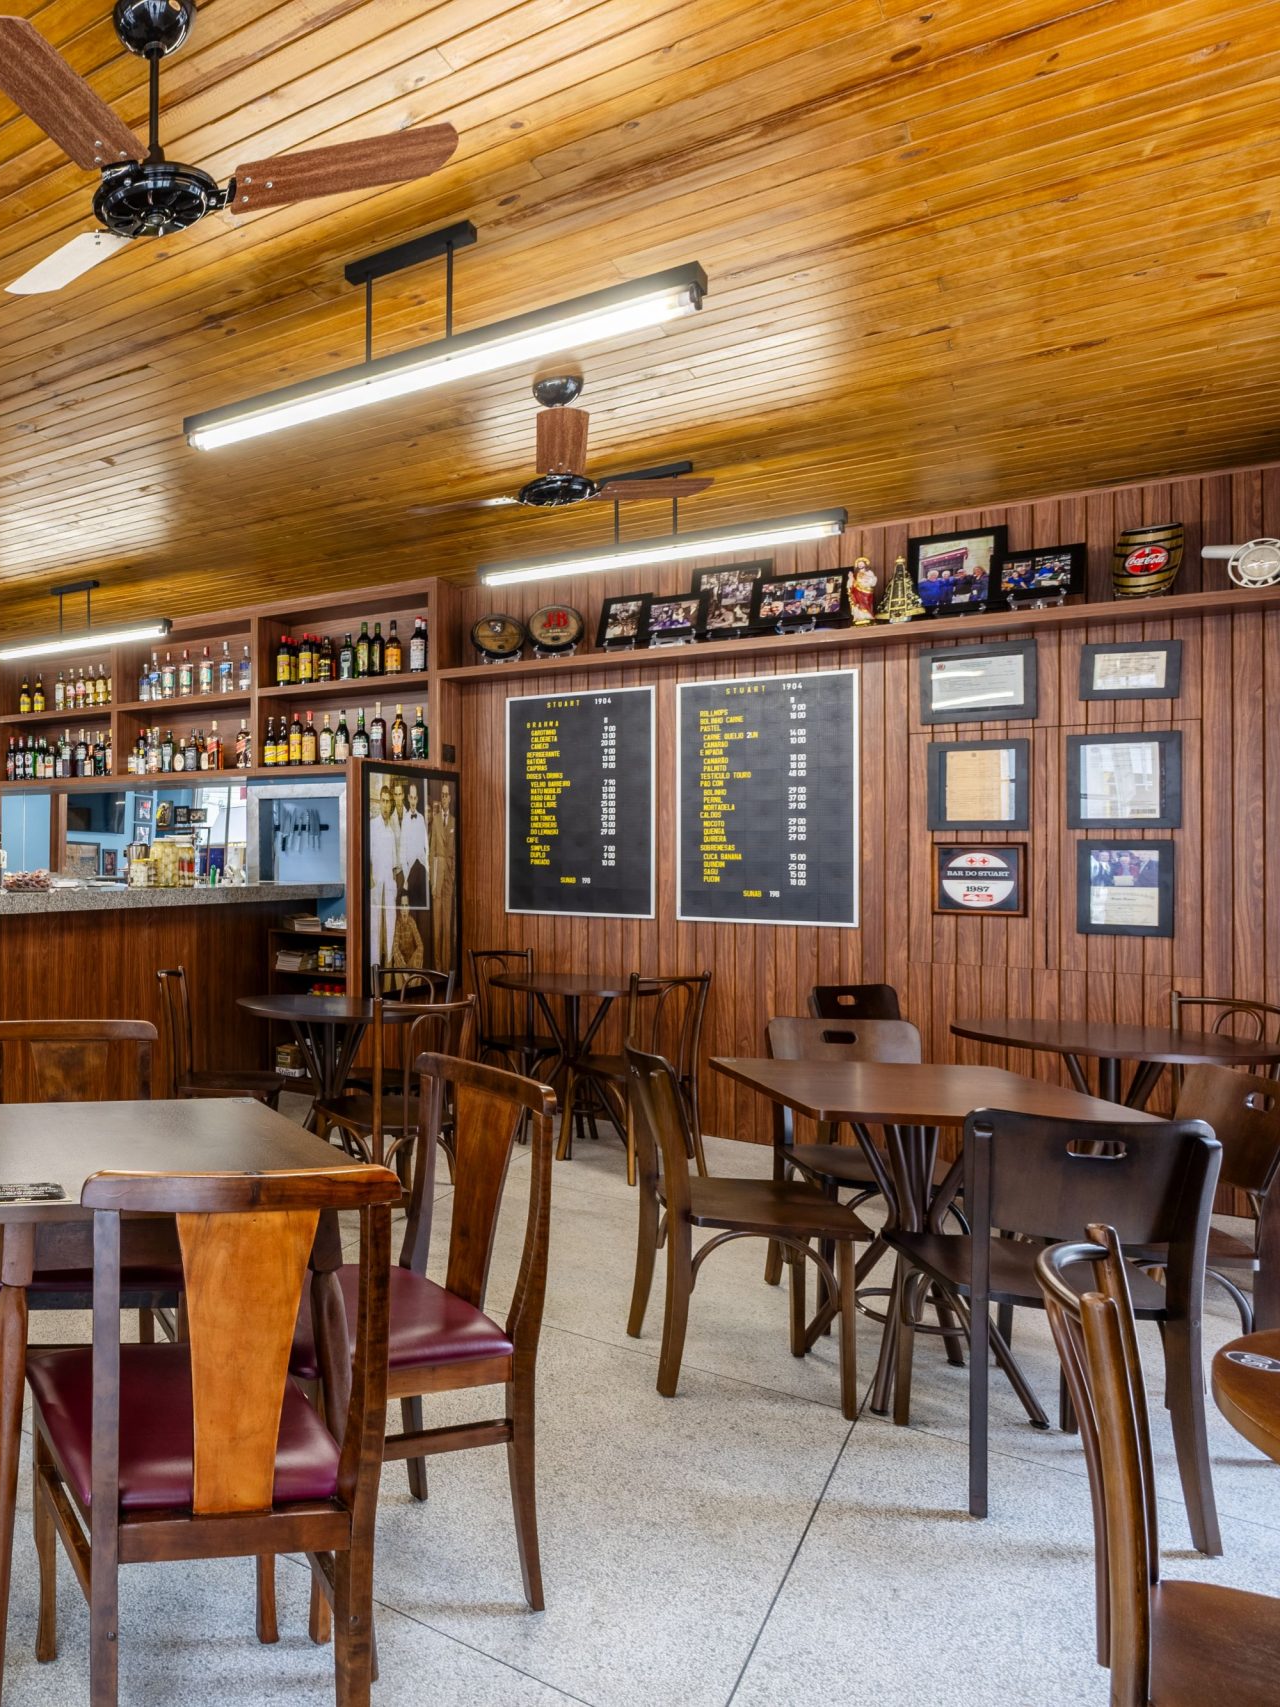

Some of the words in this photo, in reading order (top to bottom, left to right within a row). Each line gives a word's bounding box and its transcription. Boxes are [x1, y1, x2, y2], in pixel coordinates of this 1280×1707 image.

[1125, 553, 1168, 567] Coca-Cola
[725, 685, 766, 695] STUART
[547, 700, 580, 708] STUART
[526, 720, 559, 728] BRAHMA
